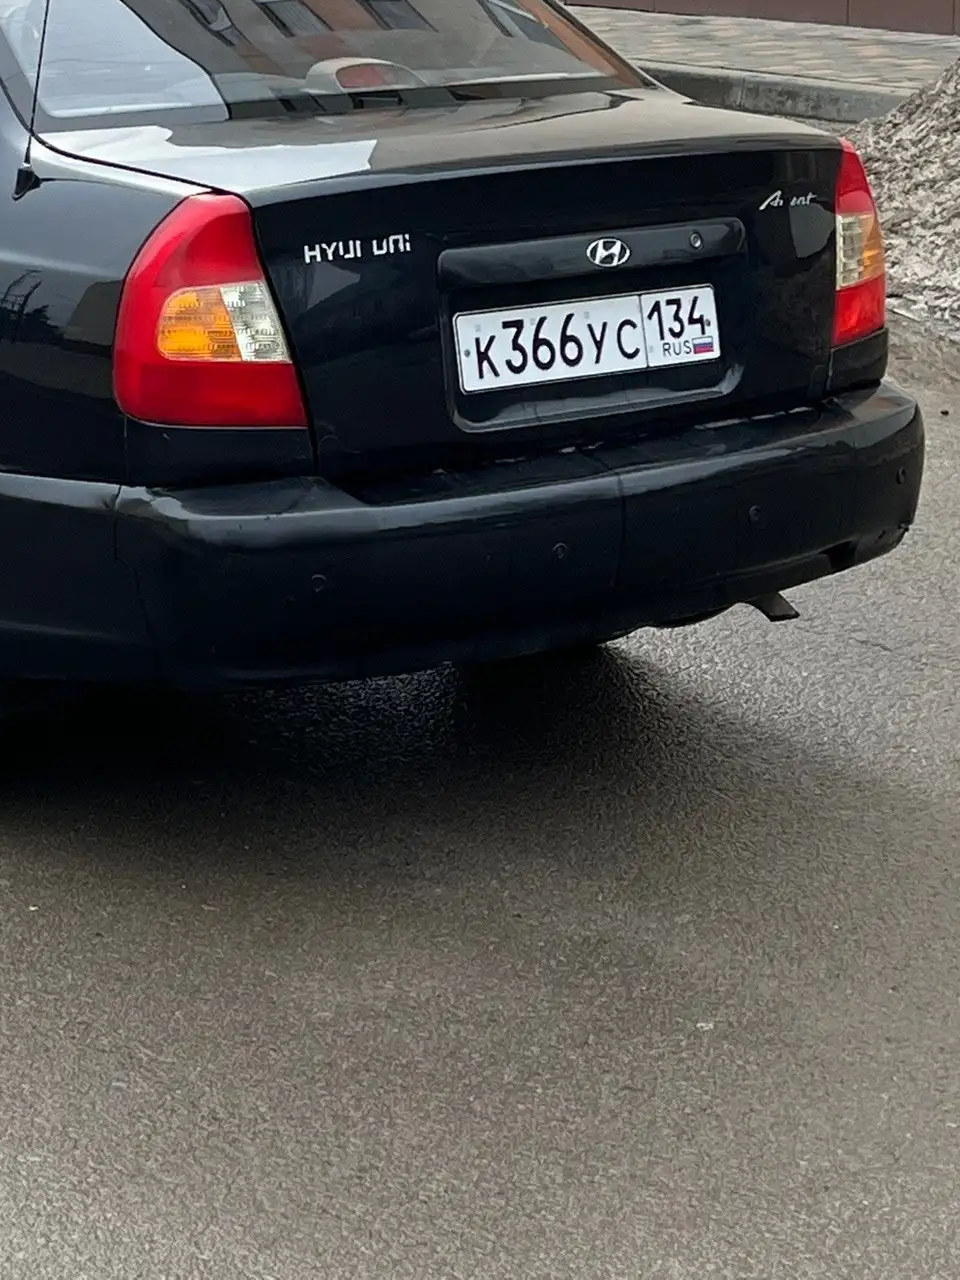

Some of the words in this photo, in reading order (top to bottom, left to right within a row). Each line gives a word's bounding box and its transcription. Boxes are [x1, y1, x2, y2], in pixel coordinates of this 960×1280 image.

[475, 312, 640, 380] К366УС
[647, 295, 706, 341] 134
[662, 340, 692, 357] RUS
